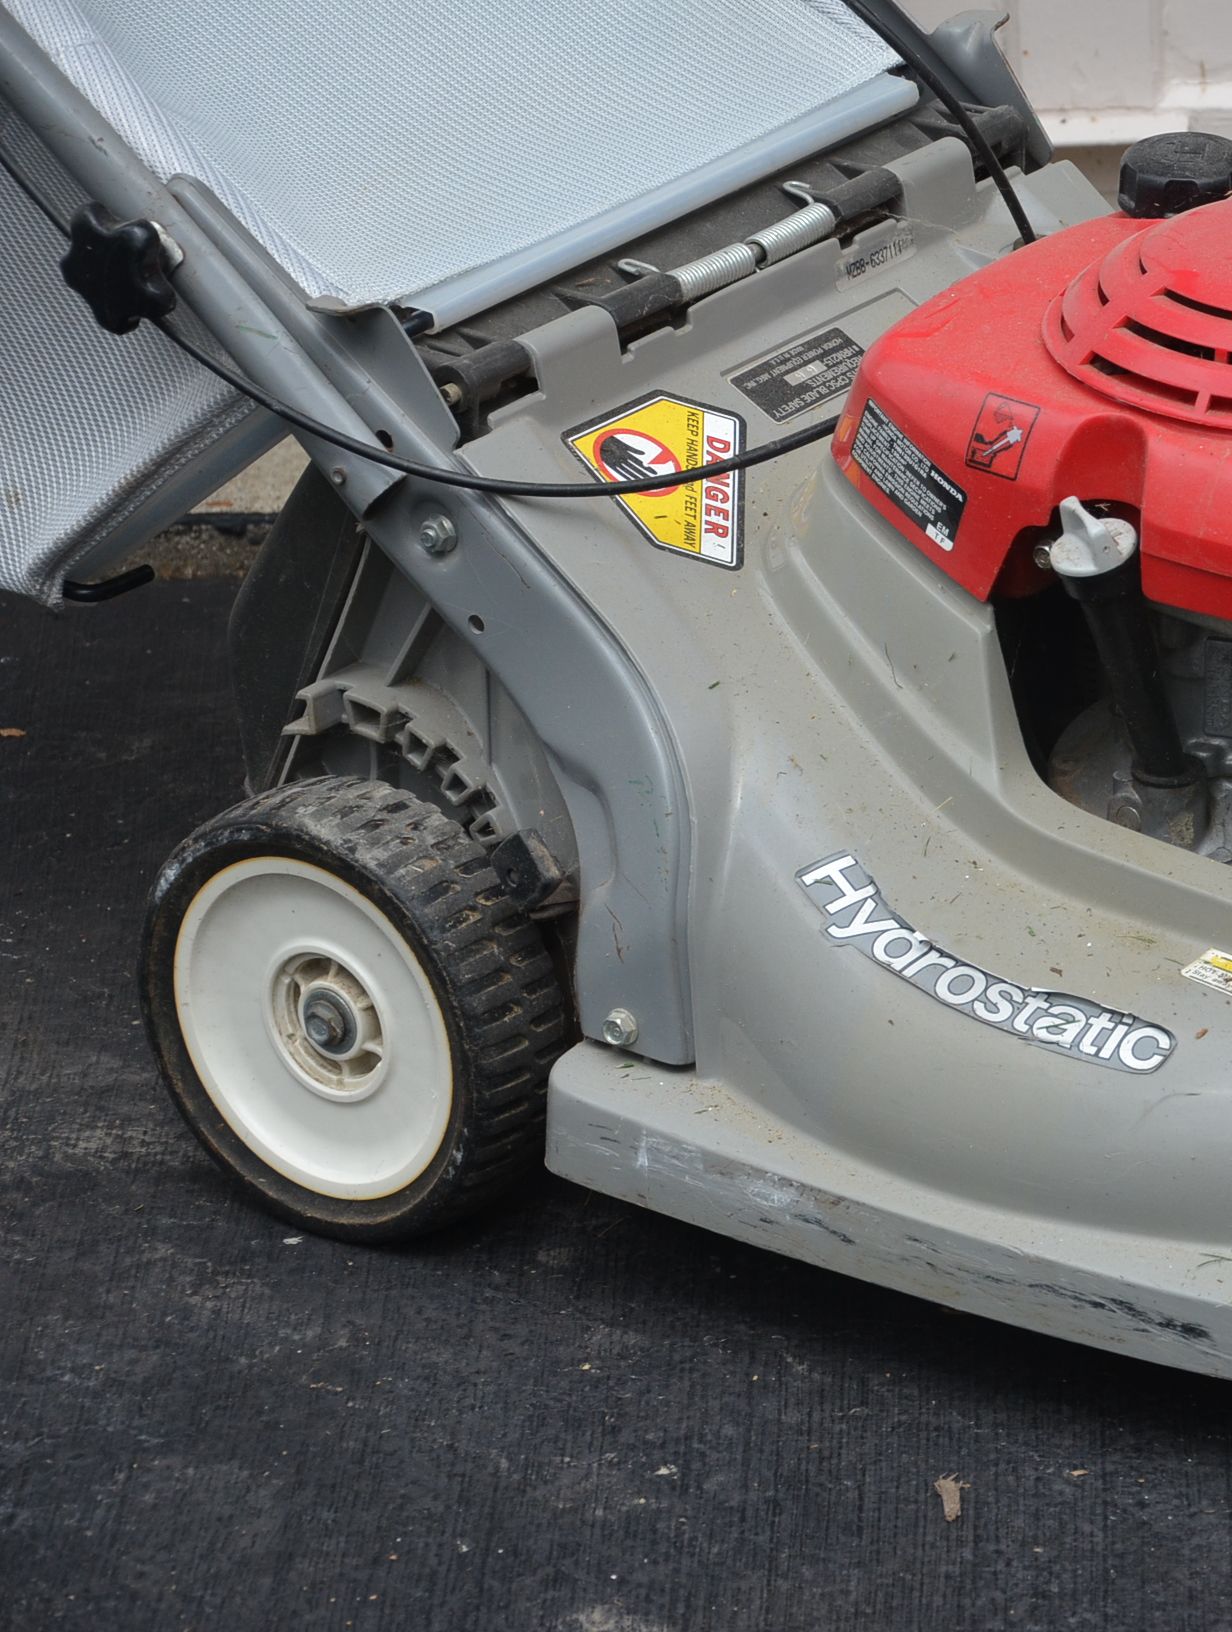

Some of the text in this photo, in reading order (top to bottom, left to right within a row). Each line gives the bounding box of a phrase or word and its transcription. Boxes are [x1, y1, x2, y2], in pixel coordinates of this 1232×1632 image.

[800, 384, 829, 403] BLADE
[771, 396, 804, 418] SAFETY
[686, 410, 700, 437] KEEP
[704, 435, 731, 539] DANGER
[930, 470, 963, 502] HONDA
[684, 494, 698, 520] FEET
[683, 519, 697, 549] AWAY
[936, 522, 949, 537] EM
[799, 854, 1172, 1071] Hydrostatic
[1192, 968, 1210, 982] Stay
